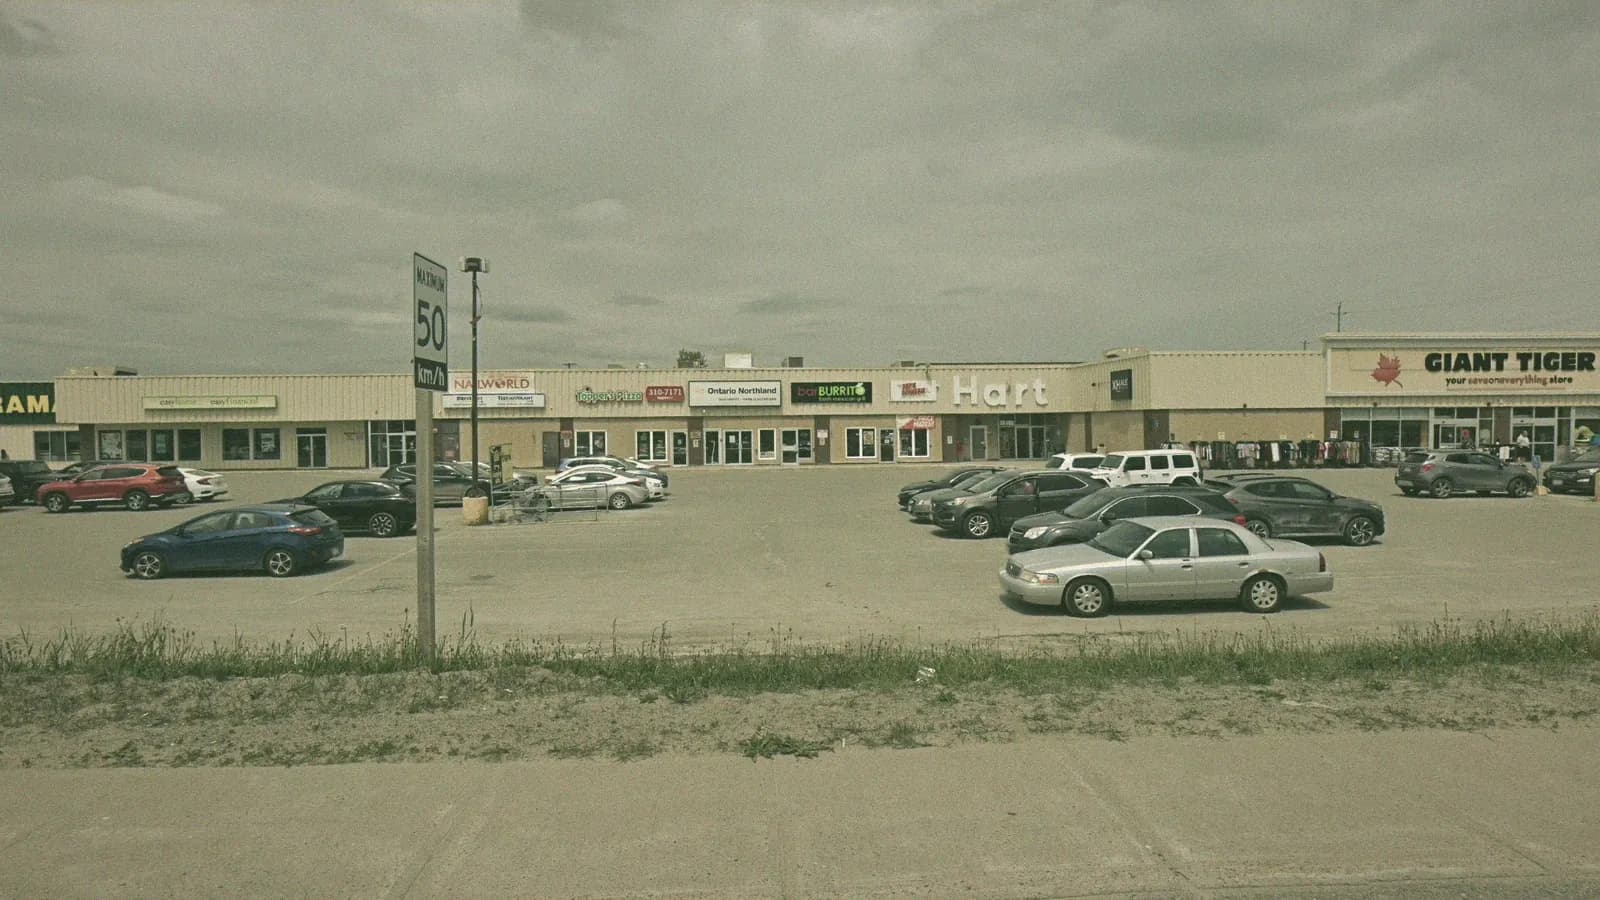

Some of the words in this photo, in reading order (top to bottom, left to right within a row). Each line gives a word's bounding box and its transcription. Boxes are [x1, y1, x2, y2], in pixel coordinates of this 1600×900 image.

[417, 265, 445, 293] MAXIMUM
[417, 299, 445, 351] 50
[1425, 352, 1508, 371] GIANT
[1517, 352, 1596, 371] TIGER
[418, 363, 445, 386] km/h
[454, 378, 530, 389] NALWORLD
[1446, 377, 1466, 386] your
[1550, 376, 1573, 384] store
[616, 391, 643, 401] Pizza
[648, 387, 682, 397] 310-7171
[953, 375, 1049, 407] Hart
[0, 395, 56, 413] AM
